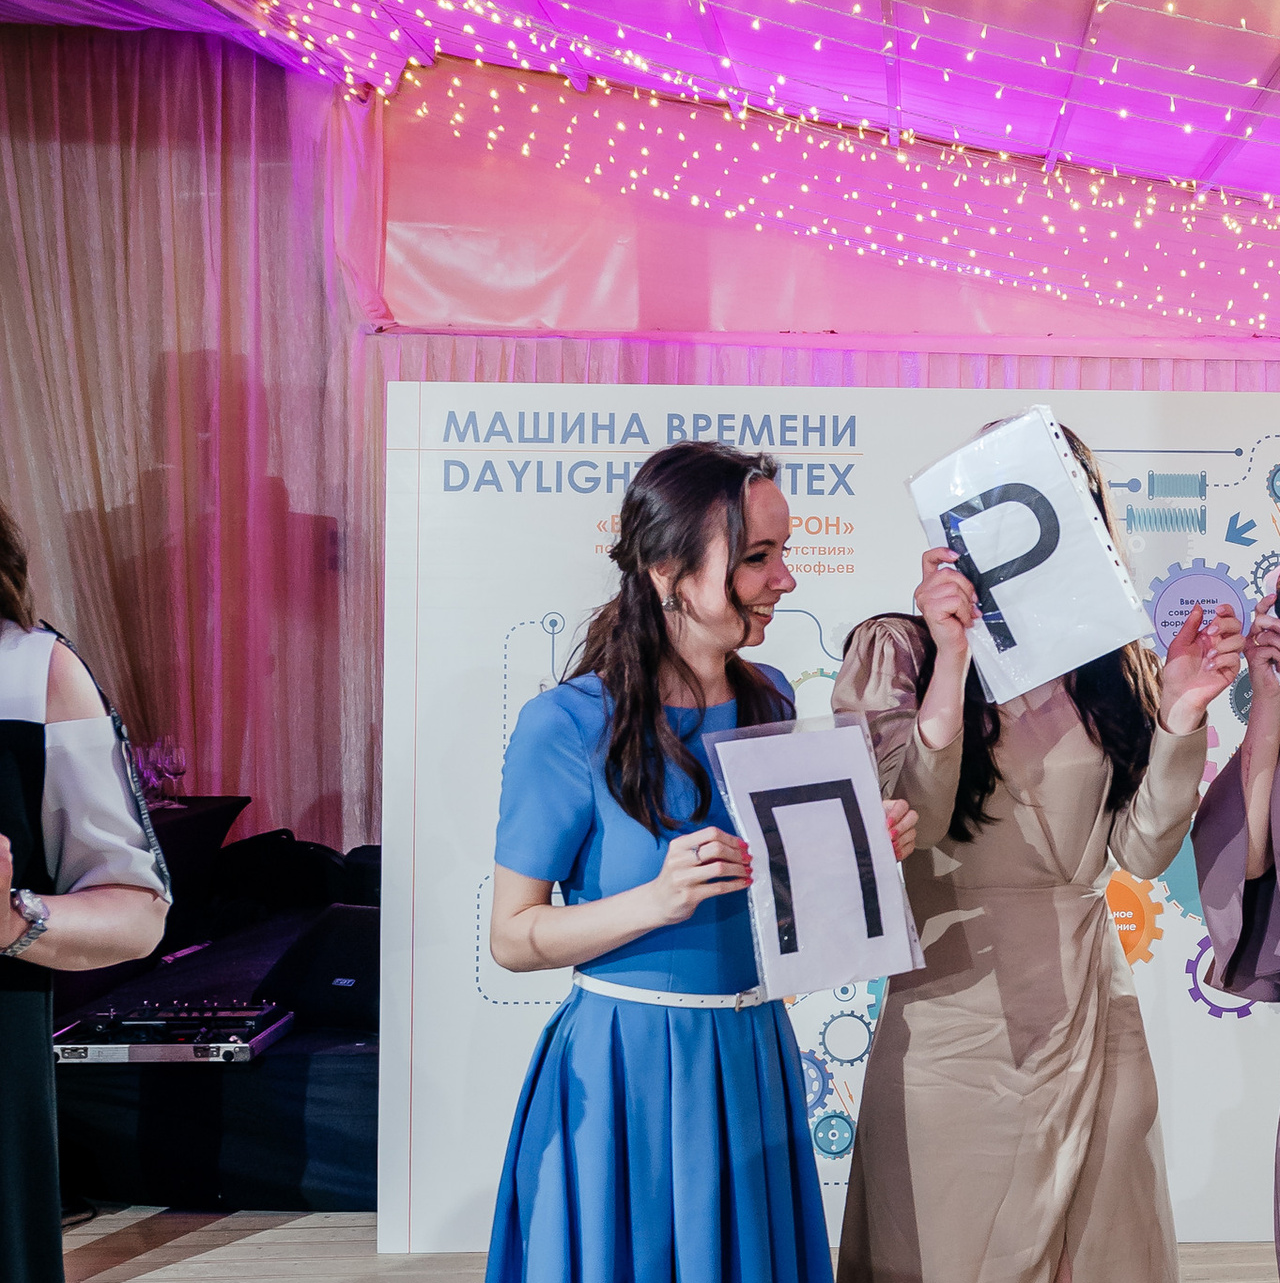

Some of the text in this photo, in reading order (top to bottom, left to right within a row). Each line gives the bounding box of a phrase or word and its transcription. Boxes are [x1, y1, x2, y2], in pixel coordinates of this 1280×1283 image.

[443, 410, 856, 447] МАШИНА ВРЕМЕНИ
[443, 459, 645, 494] DAYLIGH
[783, 545, 855, 559] утствия»
[787, 561, 855, 576] окофьев
[749, 778, 884, 955] П
